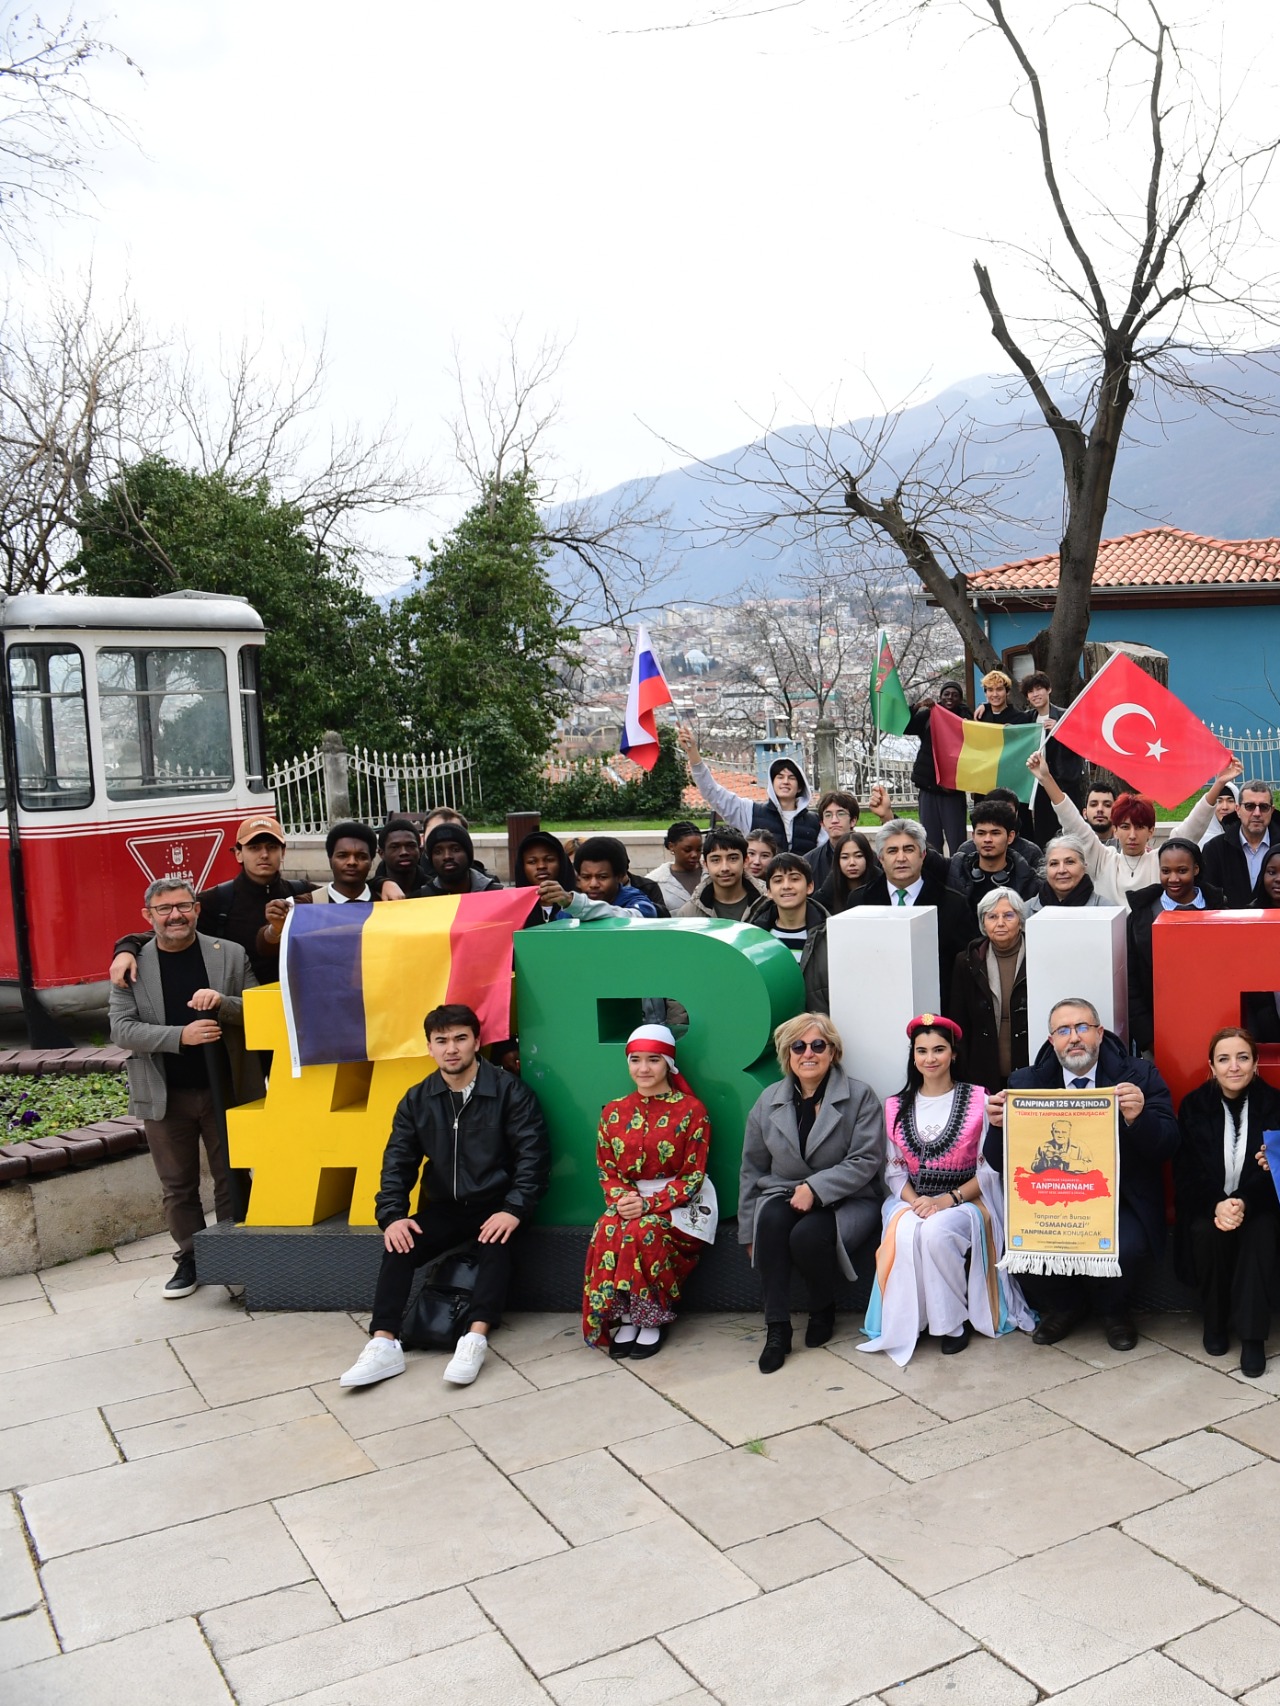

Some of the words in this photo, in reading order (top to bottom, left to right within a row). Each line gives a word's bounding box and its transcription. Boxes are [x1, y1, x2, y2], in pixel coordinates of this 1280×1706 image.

[165, 870, 193, 879] BURSA
[1070, 1100, 1108, 1109] YAŞINDA!
[1031, 1182, 1095, 1191] TANPINARNAME
